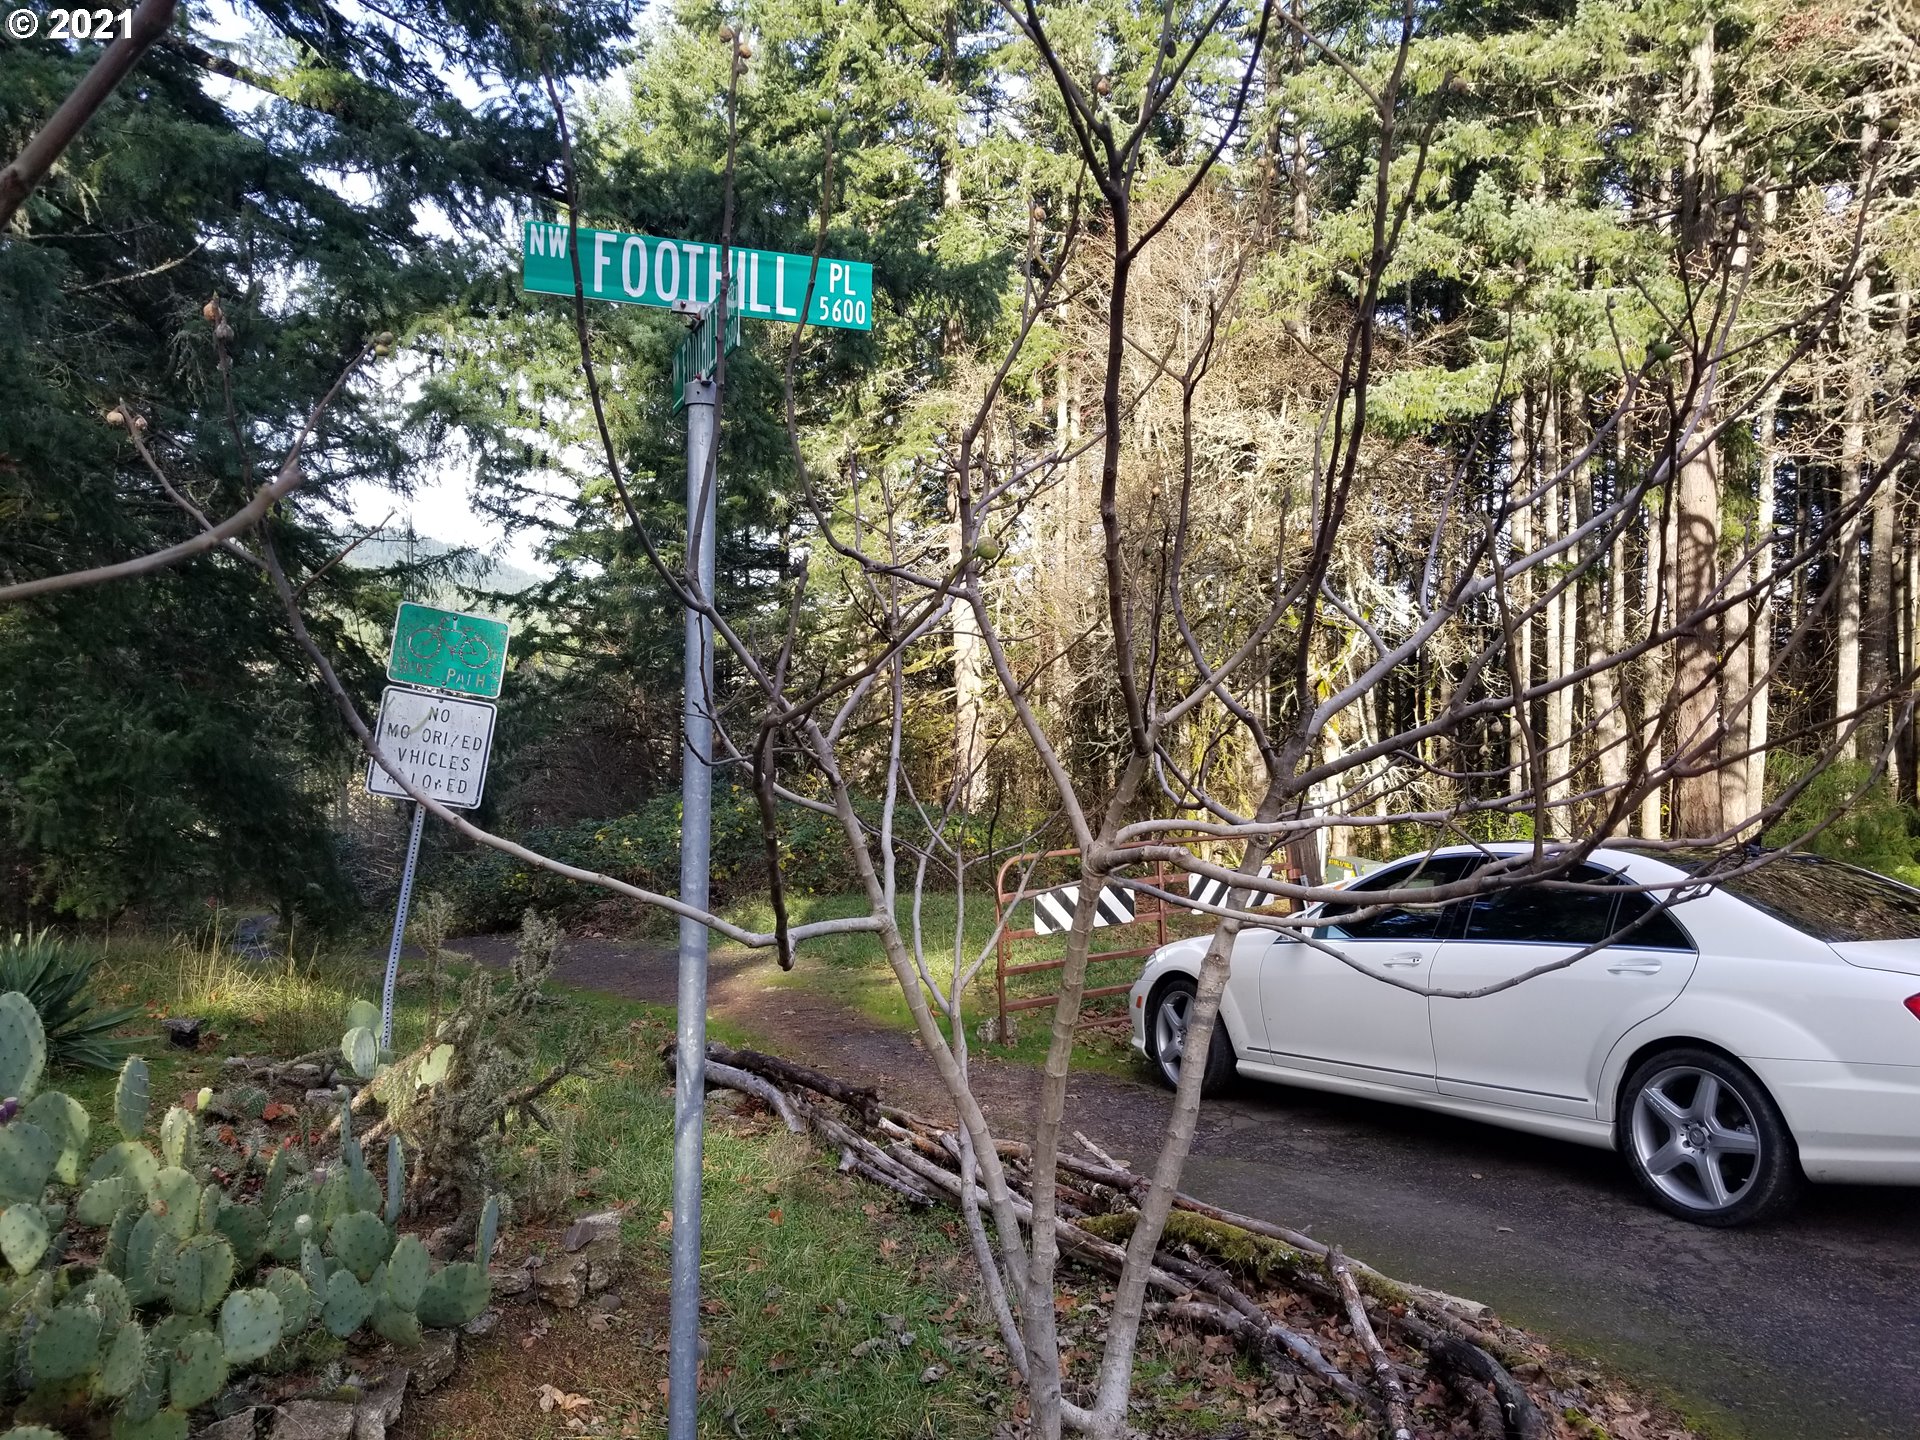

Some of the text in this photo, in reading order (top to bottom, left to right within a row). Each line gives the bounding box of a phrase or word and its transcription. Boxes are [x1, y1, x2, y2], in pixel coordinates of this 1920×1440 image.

[529, 225, 568, 259] NW
[594, 231, 797, 316] FOOTHILL
[829, 262, 856, 295] PL
[819, 296, 866, 325] 5600
[428, 706, 450, 723] NO
